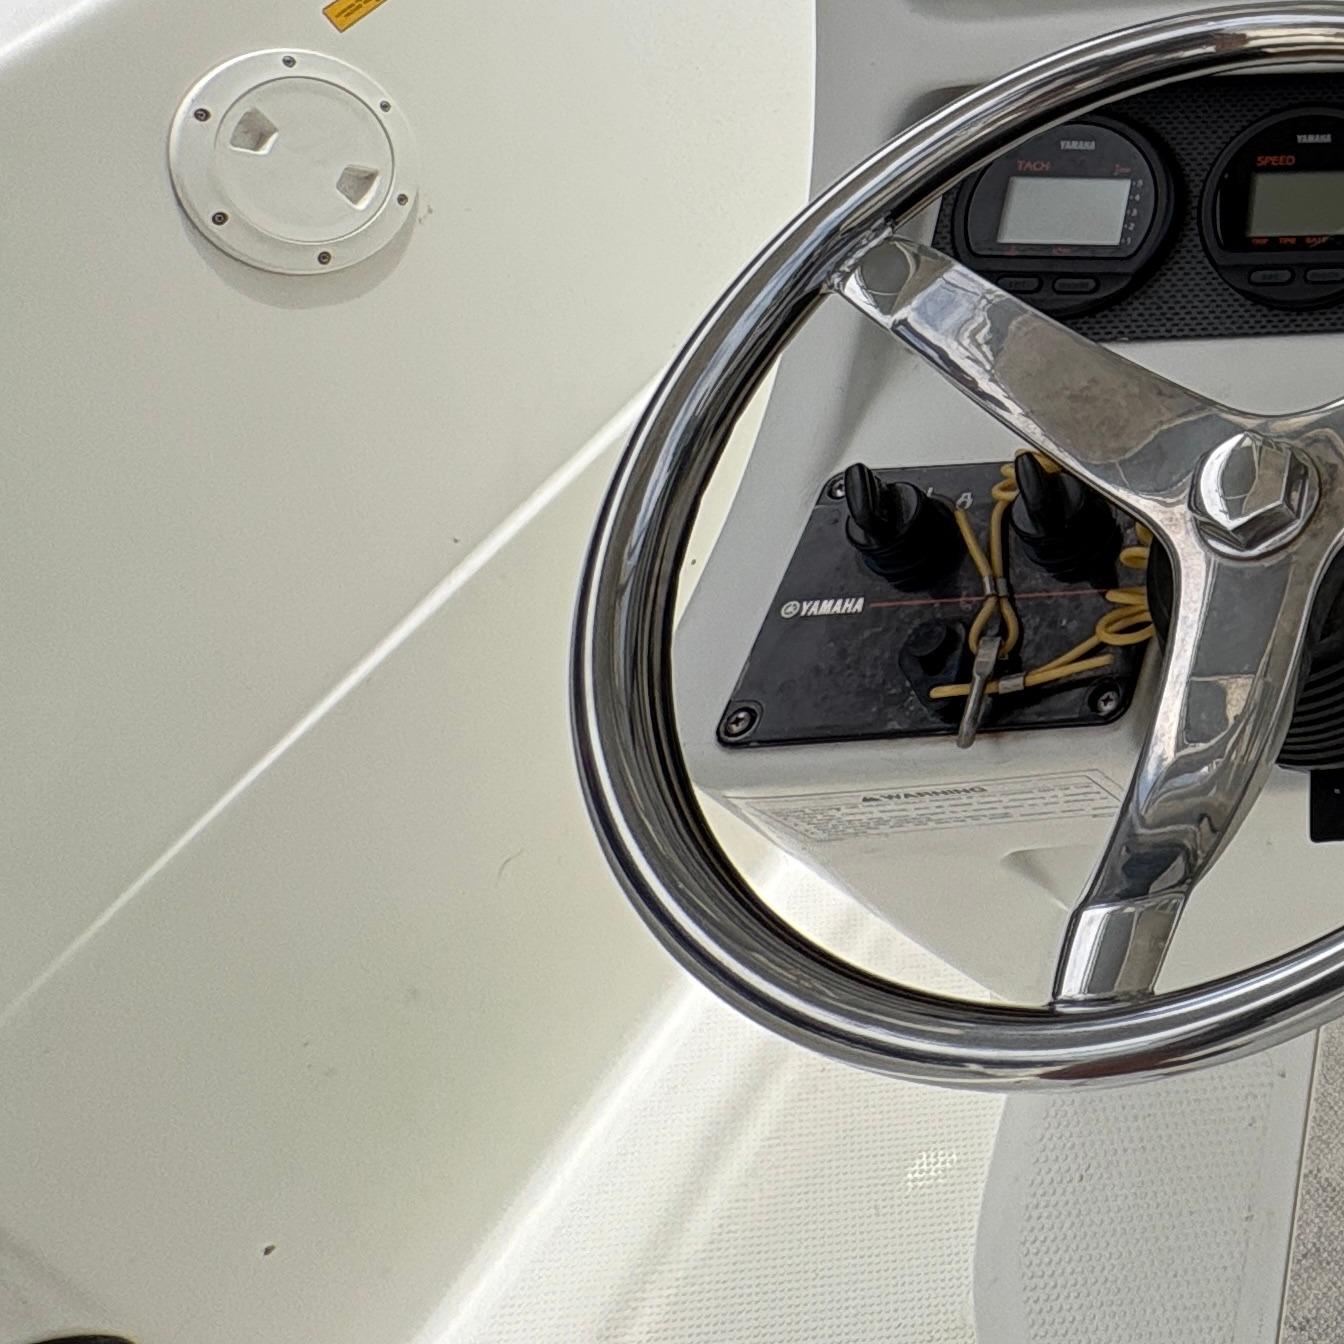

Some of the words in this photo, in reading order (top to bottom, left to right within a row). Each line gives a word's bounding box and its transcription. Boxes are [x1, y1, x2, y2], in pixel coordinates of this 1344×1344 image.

[1296, 133, 1333, 144] YAMAHA
[1060, 140, 1097, 151] YAMAHA
[1016, 159, 1050, 172] TACH
[1256, 155, 1296, 167] SPEED
[800, 596, 865, 617] YAMAHA
[880, 786, 988, 802] WARNING
